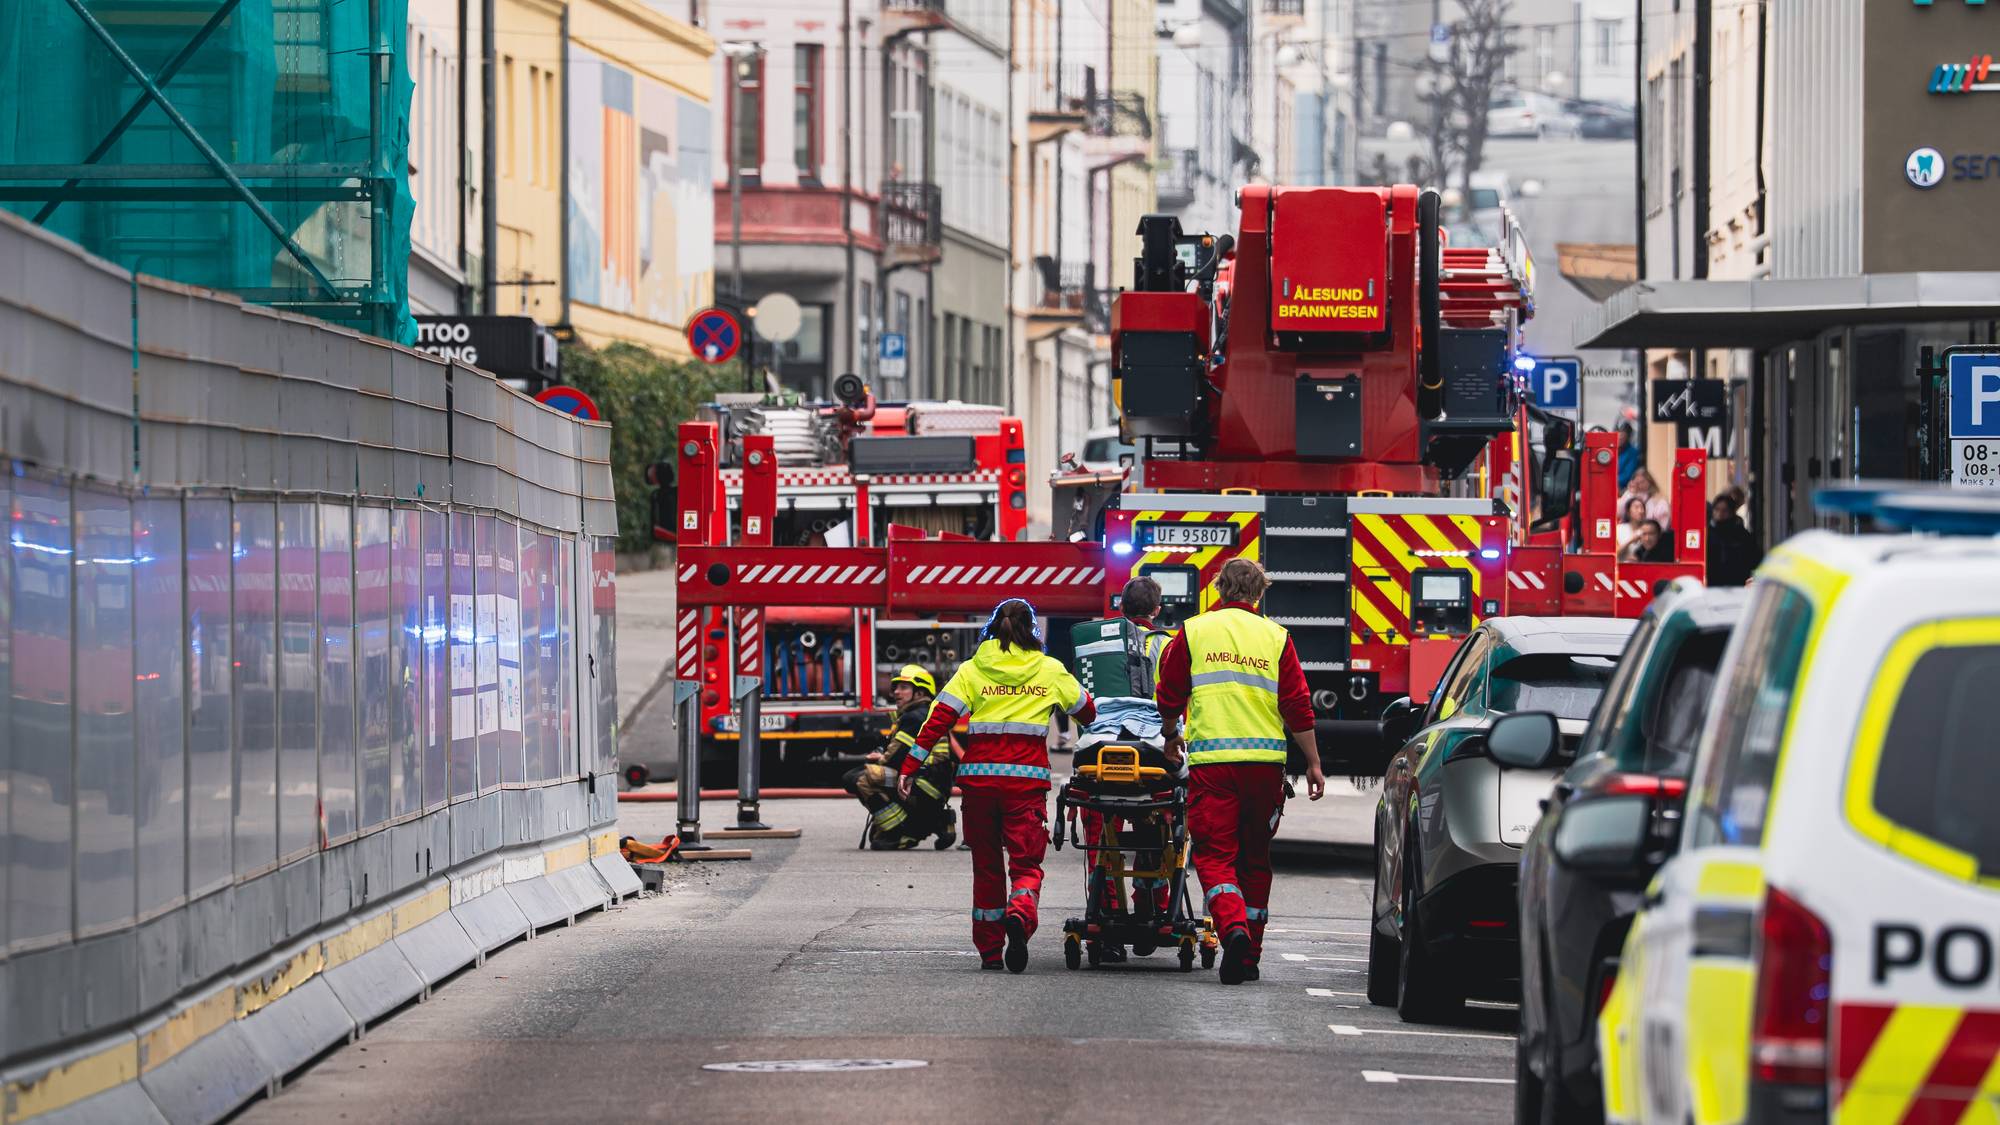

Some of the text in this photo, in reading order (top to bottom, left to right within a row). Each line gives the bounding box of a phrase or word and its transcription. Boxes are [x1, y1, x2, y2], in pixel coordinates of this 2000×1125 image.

[1293, 284, 1363, 301] ÅLESUND
[1279, 304, 1378, 318] BRANNVESEN
[886, 335, 901, 355] P
[1582, 366, 1634, 378] Automat
[1543, 368, 1568, 404] P
[1971, 366, 2000, 426] P
[1960, 478, 1984, 486] Maks
[1158, 528, 1228, 543] UF 95807
[1205, 651, 1270, 671] AMBULANSE
[981, 684, 1048, 697] AMBULANSE
